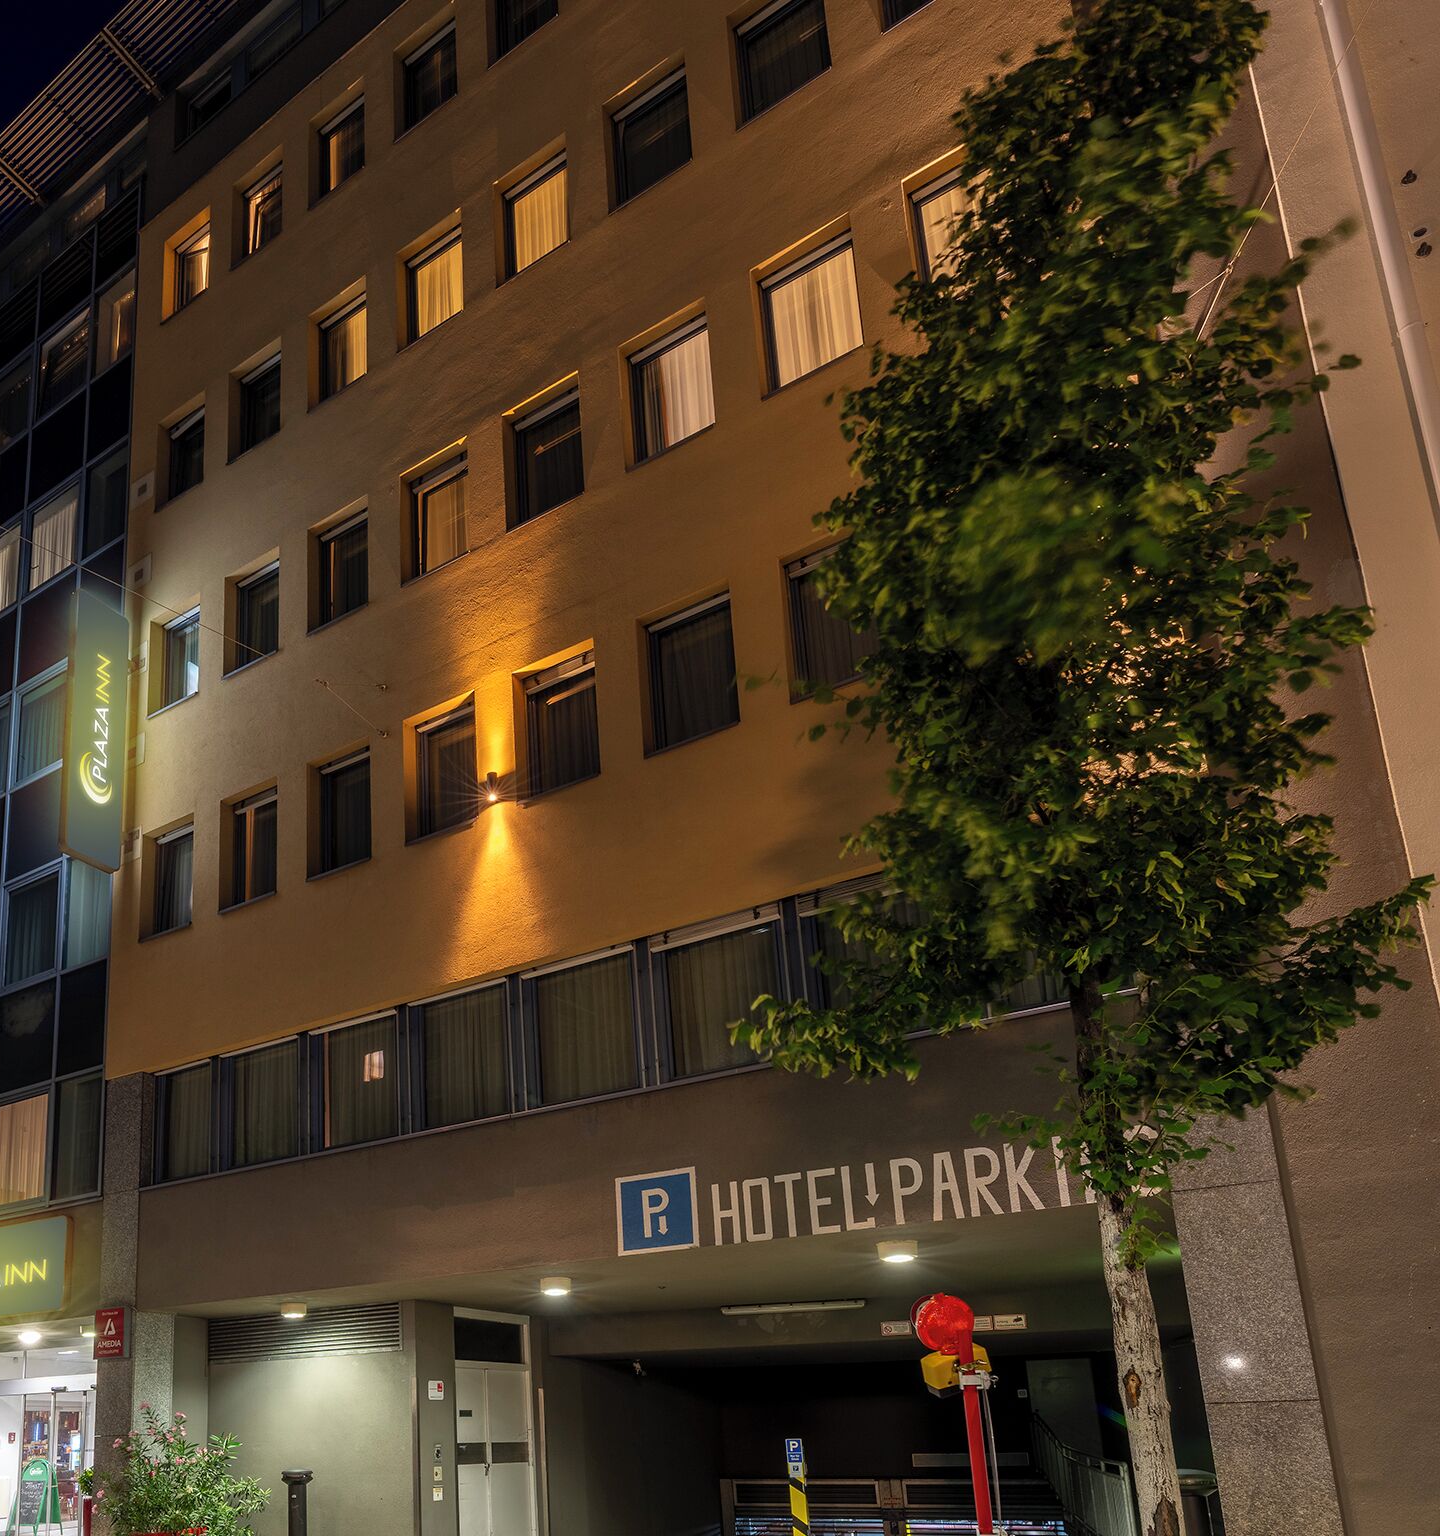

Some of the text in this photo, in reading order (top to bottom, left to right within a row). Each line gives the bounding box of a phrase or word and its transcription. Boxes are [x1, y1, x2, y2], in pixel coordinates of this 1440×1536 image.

[92, 653, 111, 783] PLAZA INN
[711, 1124, 1165, 1246] HOTEL PARKIG
[641, 1187, 669, 1238] P
[4, 1258, 47, 1286] INN
[97, 1340, 121, 1348] AMEDIA
[789, 1440, 799, 1452] P
